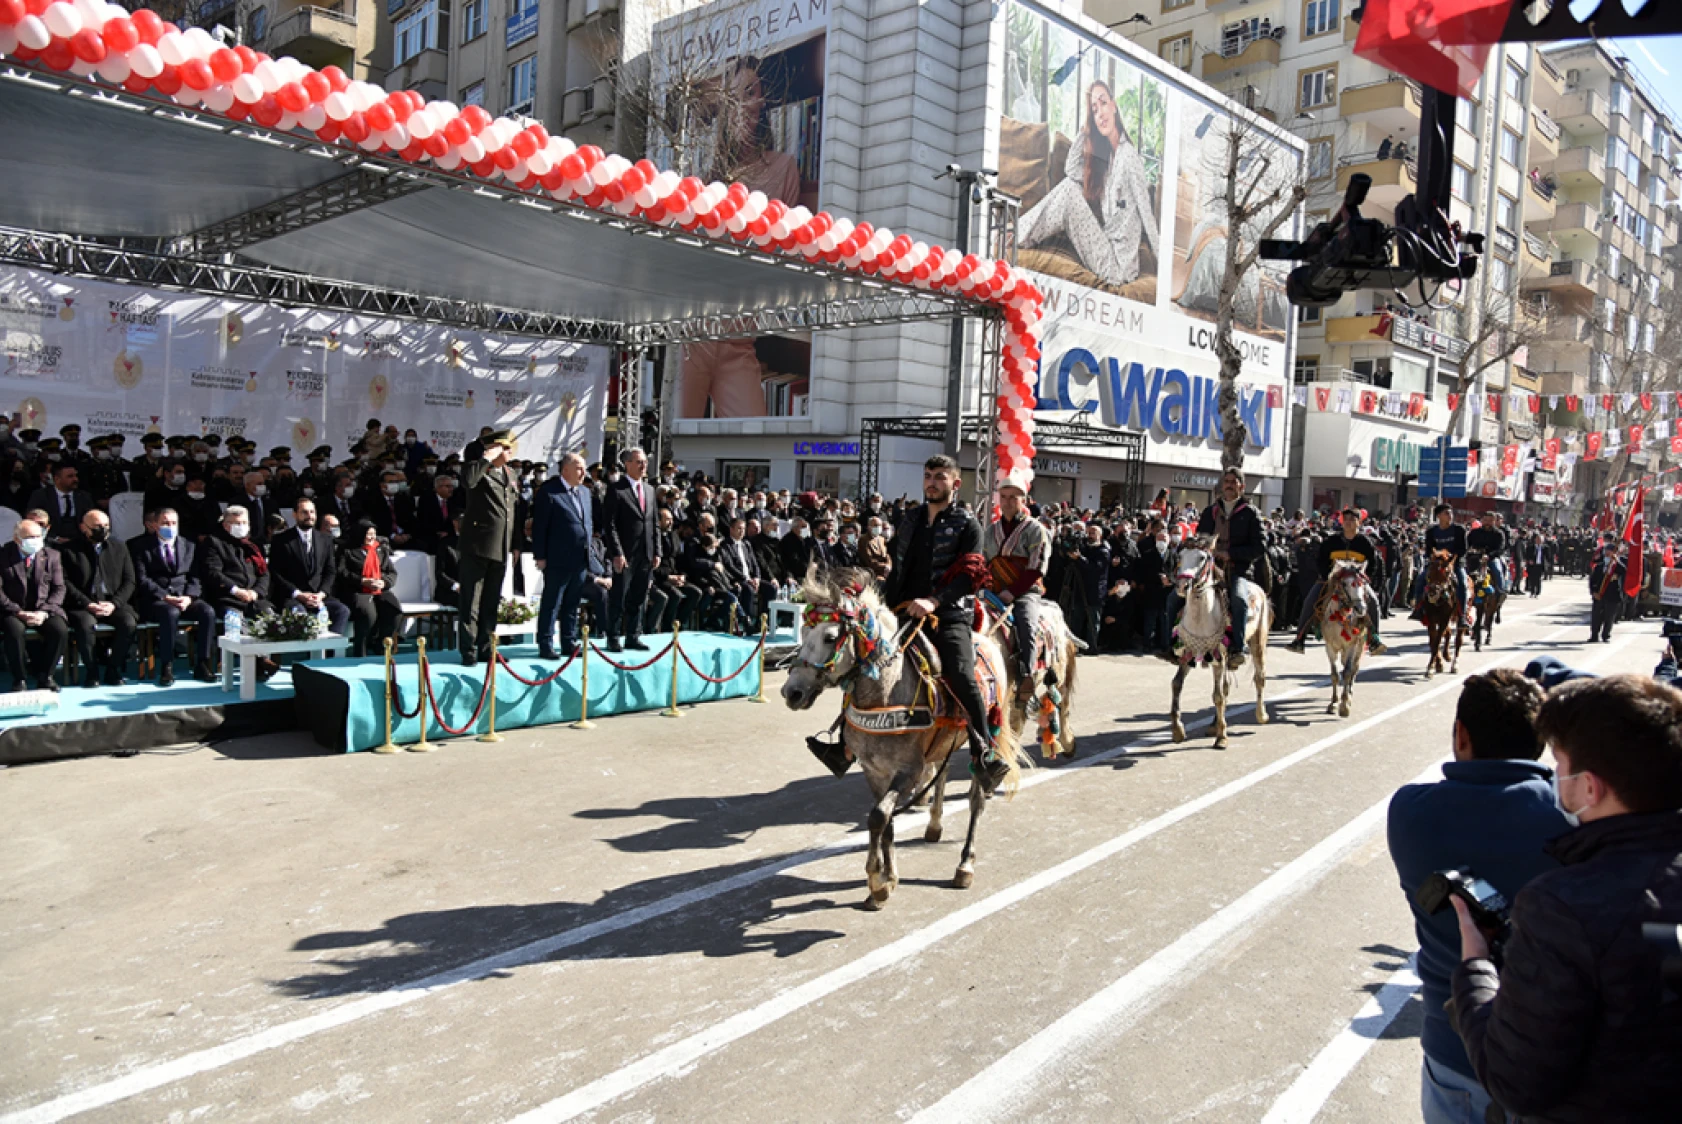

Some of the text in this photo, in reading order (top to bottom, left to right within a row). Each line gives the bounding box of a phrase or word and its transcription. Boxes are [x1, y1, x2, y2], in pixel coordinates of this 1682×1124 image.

[727, 0, 827, 48] DREAM
[1066, 292, 1144, 335] DREAM
[793, 441, 809, 455] LC
